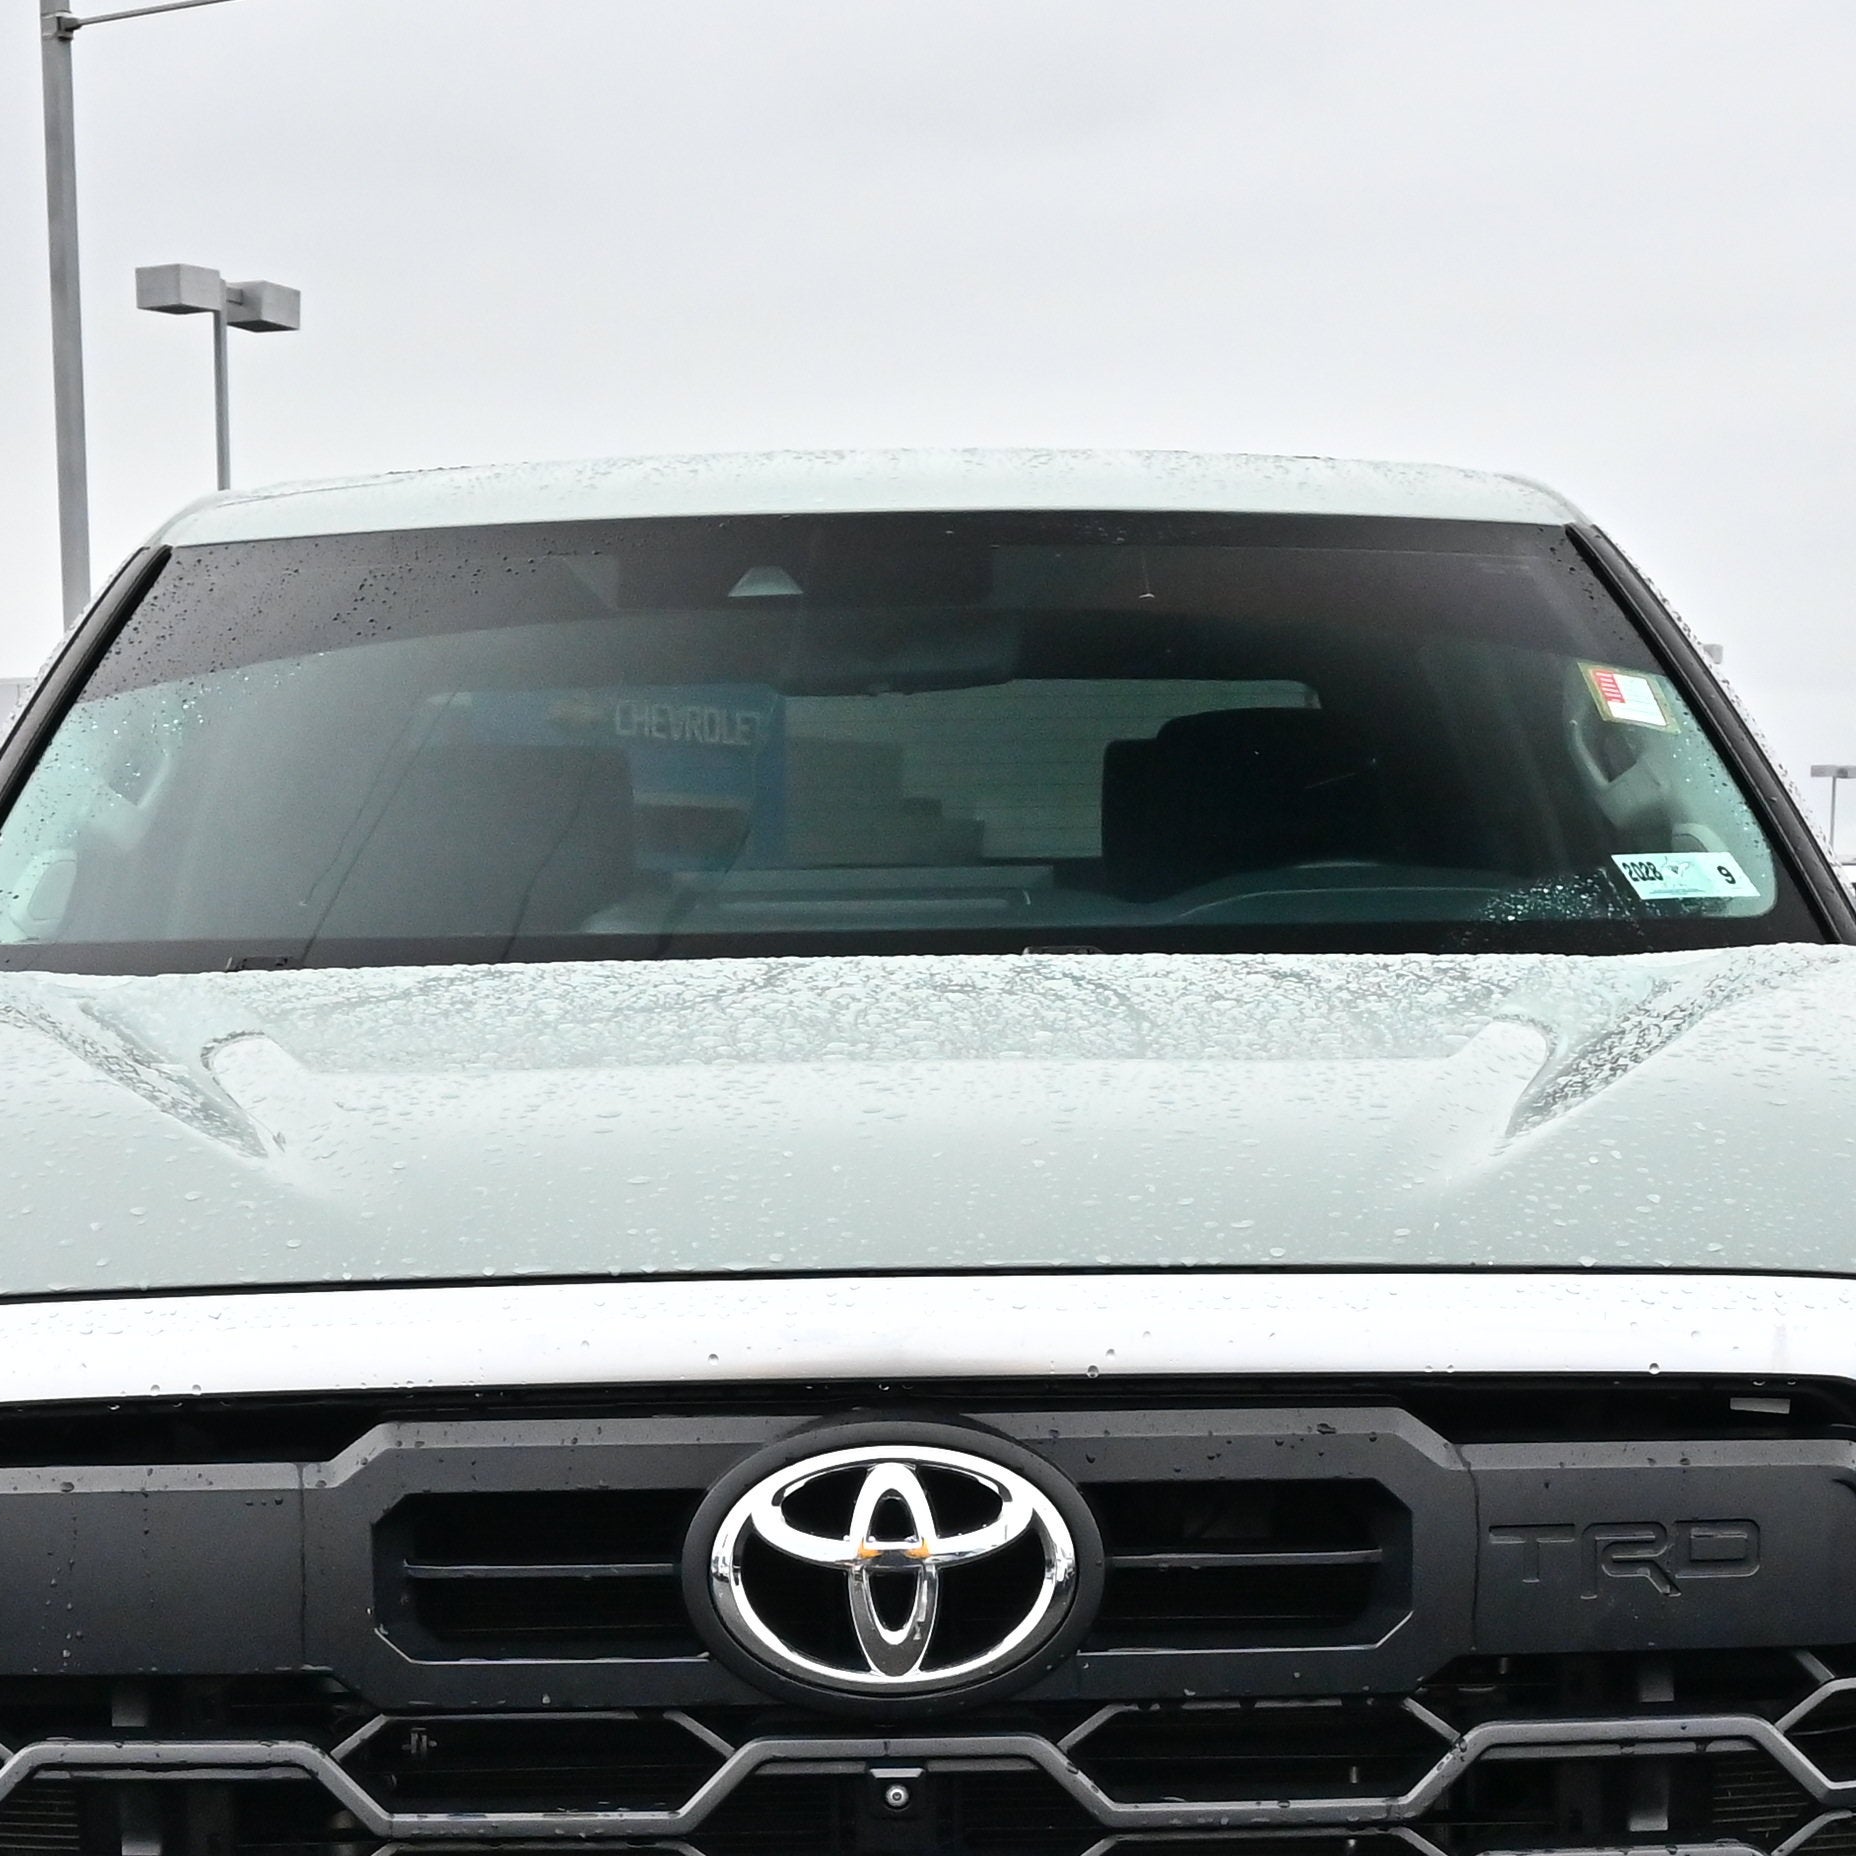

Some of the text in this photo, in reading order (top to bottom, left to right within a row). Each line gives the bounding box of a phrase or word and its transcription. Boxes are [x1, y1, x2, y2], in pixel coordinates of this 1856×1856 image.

[615, 699, 766, 746] CHEVROLET
[1622, 861, 1736, 884] 2028 9
[1488, 1517, 1761, 1600] TRD
